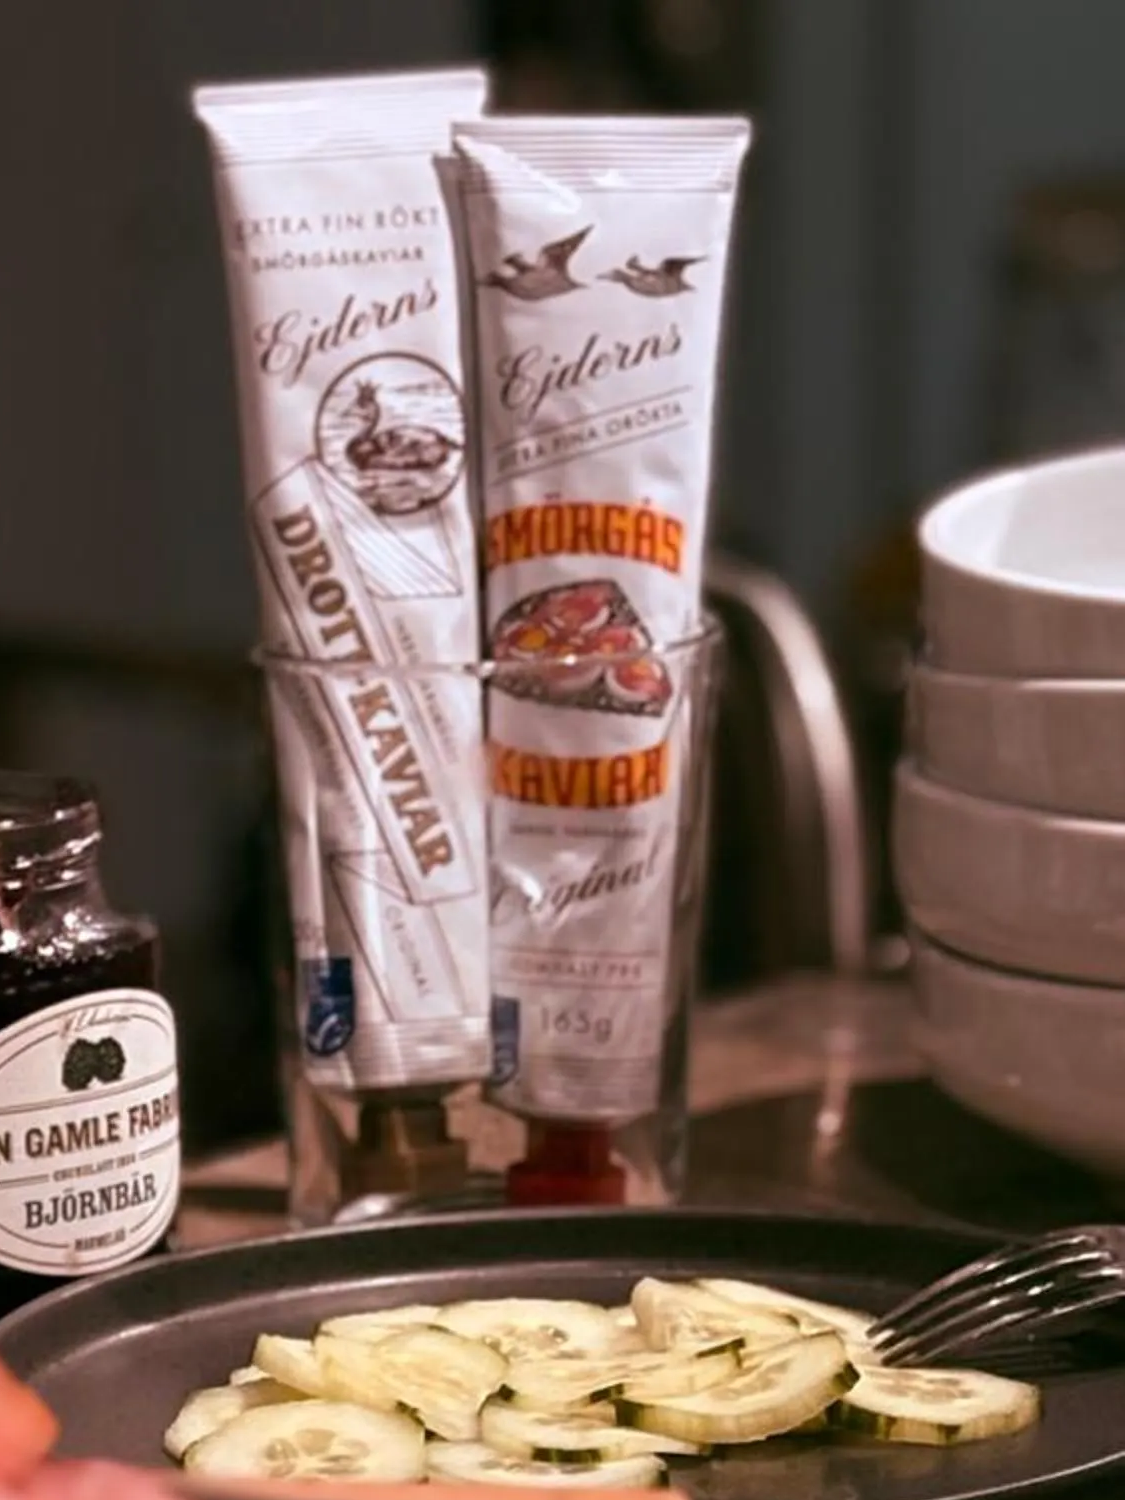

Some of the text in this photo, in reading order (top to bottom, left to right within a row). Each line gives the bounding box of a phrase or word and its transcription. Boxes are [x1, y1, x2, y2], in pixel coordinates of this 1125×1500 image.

[253, 277, 439, 389] Ejderns
[493, 322, 684, 428] Ejderns
[485, 490, 685, 576] SMÖRGÅS
[493, 738, 669, 810] KAVIAR
[540, 1005, 614, 1045] 165g
[24, 1111, 122, 1159] GAMLE
[24, 1171, 159, 1230] BJÖRNBÄR
